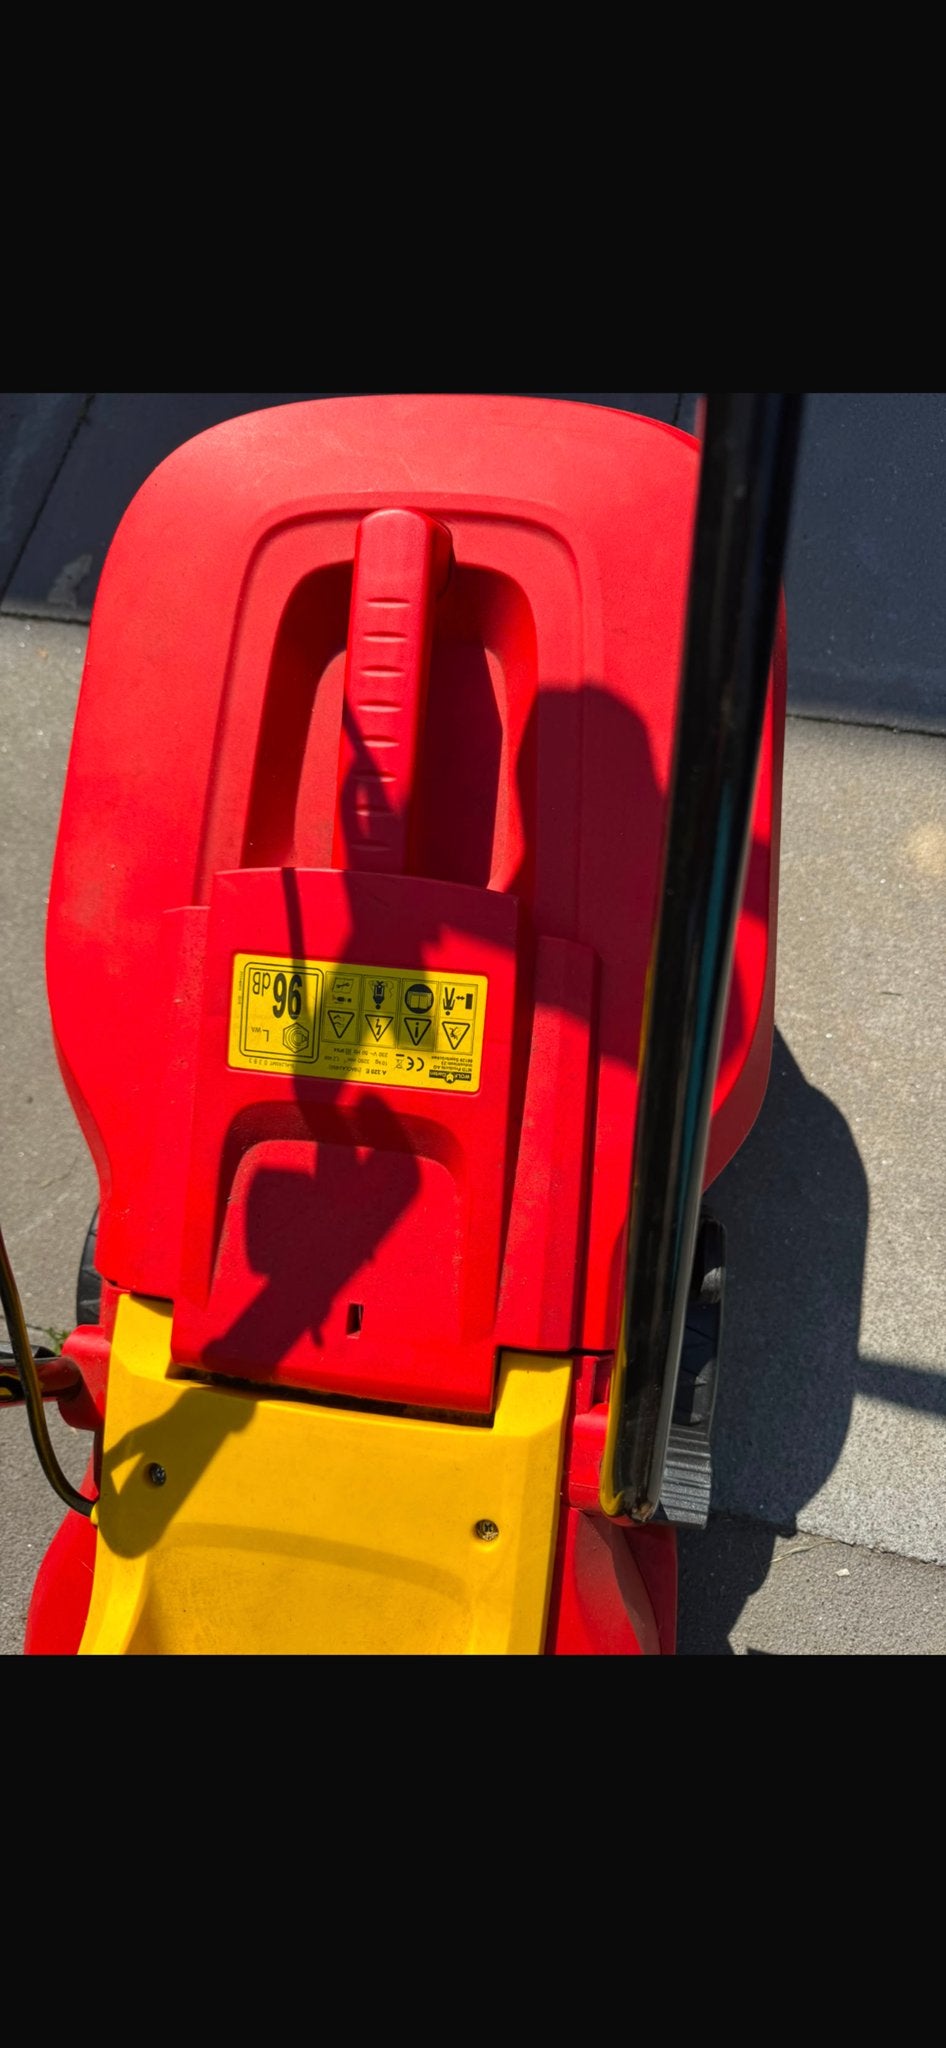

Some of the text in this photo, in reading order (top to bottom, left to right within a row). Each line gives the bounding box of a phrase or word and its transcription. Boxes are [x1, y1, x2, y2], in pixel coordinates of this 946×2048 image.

[252, 971, 271, 996] dB
[273, 972, 302, 1020] 96
[406, 1056, 424, 1071] CE
